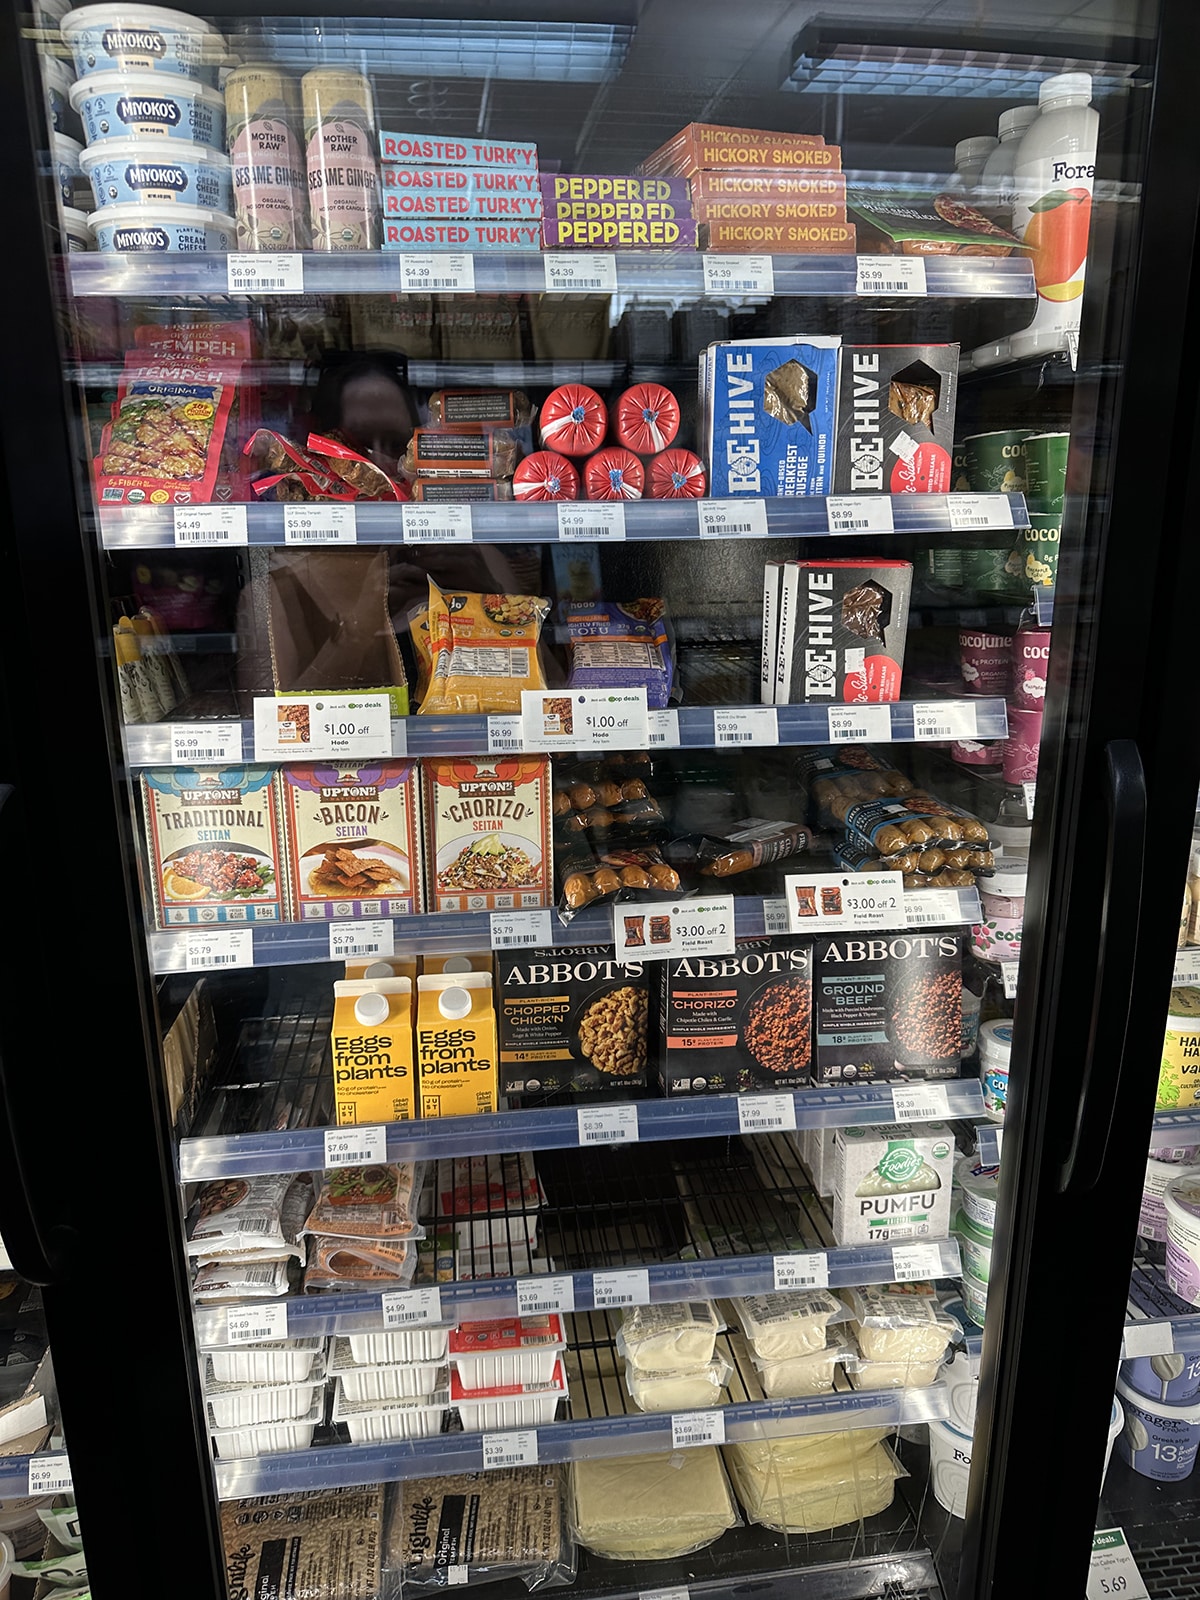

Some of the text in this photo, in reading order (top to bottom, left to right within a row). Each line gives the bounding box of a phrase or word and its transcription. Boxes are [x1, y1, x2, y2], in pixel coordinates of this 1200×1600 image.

[106, 33, 161, 51] MIYOKO'S
[121, 101, 176, 119] MIYOKO'S
[189, 110, 212, 122] CREAM
[251, 133, 286, 143] MOTHER
[323, 135, 358, 144] MOTHER
[259, 142, 280, 150] RAW
[330, 144, 351, 152] RAW
[384, 139, 533, 165] ROASTED TURK'Y
[704, 148, 832, 164] HICKORY SMOKED
[129, 168, 184, 185] MIYOKO'S
[235, 165, 272, 187] SESAME
[309, 168, 344, 190] SESAME
[384, 170, 535, 191] ROASTED TURK'Y
[554, 178, 671, 200] PEPPERED
[709, 178, 837, 193] HICKORY SMOKED
[387, 196, 538, 214] ROASTED TURK'Y
[556, 202, 675, 220] PEPPERED
[706, 203, 837, 218] HICKORY SMOKED
[387, 226, 537, 243] ROASTED TURK'Y
[558, 221, 680, 243] PEPPERED
[719, 227, 848, 241] HICKORY SMOKED
[116, 232, 165, 248] MIYOKO'S
[178, 235, 206, 245] CREAM
[231, 268, 256, 276] $6.99
[405, 268, 430, 276] $4.39
[550, 268, 574, 276] $4.39
[708, 269, 732, 277] $4.39
[860, 271, 882, 279] $5.99
[136, 367, 223, 382] TEMPEH
[148, 386, 198, 395] ORIGINAL
[817, 433, 827, 464] QUINOA
[118, 479, 143, 487] FIBER
[561, 517, 584, 525] $4.99
[704, 515, 726, 523] $8.99
[831, 511, 853, 519] $8.99
[177, 521, 200, 529] $4.49
[288, 520, 312, 528] $5.99
[406, 519, 429, 527] $6.39
[568, 627, 609, 636] TOFU
[959, 633, 1012, 650] cocojune
[586, 716, 628, 728] $1.00 off
[832, 720, 852, 728] $8.99
[324, 723, 370, 735] $1.00 off
[174, 739, 198, 747] $6.99
[322, 787, 376, 797] UPTON'S
[460, 782, 513, 792] UPTON'S
[182, 789, 239, 800] UPTON'S
[319, 803, 380, 826] BACON
[449, 798, 525, 823] CHORIZO
[162, 810, 264, 830] TRADITIONAL
[472, 820, 503, 831] SEITAN
[197, 829, 231, 841] SEITAN
[336, 825, 368, 837] SEITAN
[847, 898, 896, 909] $3.00 off 2
[904, 905, 923, 913] $6.99
[766, 912, 786, 921] $6.99
[493, 926, 513, 934] $5.79
[676, 923, 726, 937] $3.00 off 2
[333, 936, 354, 944] $5.79
[189, 946, 211, 954] $5.79
[821, 936, 958, 963] ABBOT'S
[673, 949, 808, 978] ABBOT'S
[504, 960, 644, 985] ABBOT'S
[823, 984, 885, 995] GROUND
[832, 994, 877, 1006] "BEEF"
[503, 1005, 571, 1016] CHOPPED
[510, 1015, 564, 1026] CHICK'N
[420, 1029, 476, 1047] Eggs
[335, 1035, 393, 1054] Eggs
[335, 1051, 391, 1066] from
[420, 1045, 475, 1060] from
[422, 1058, 491, 1077] plants
[336, 1065, 408, 1084] plants
[327, 1143, 348, 1151] $7.69
[880, 1158, 922, 1174] Foodies
[860, 1193, 936, 1216] PUMFU
[868, 1228, 890, 1240] 17g
[777, 1268, 795, 1276] $6.99
[594, 1287, 612, 1295] $6.99
[519, 1294, 538, 1302] $3.69
[385, 1304, 405, 1313] $4.99
[229, 1321, 249, 1329] $4.69
[674, 1426, 692, 1434] $3.69
[485, 1446, 504, 1455] $3.39
[1151, 1443, 1178, 1462] 13
[31, 1472, 51, 1481] $6.99
[409, 1496, 437, 1566] Lightlife
[1096, 1536, 1115, 1544] deals
[437, 1528, 451, 1565] Original
[449, 1537, 457, 1565] TEMPEH
[1101, 1576, 1127, 1593] 5.69
